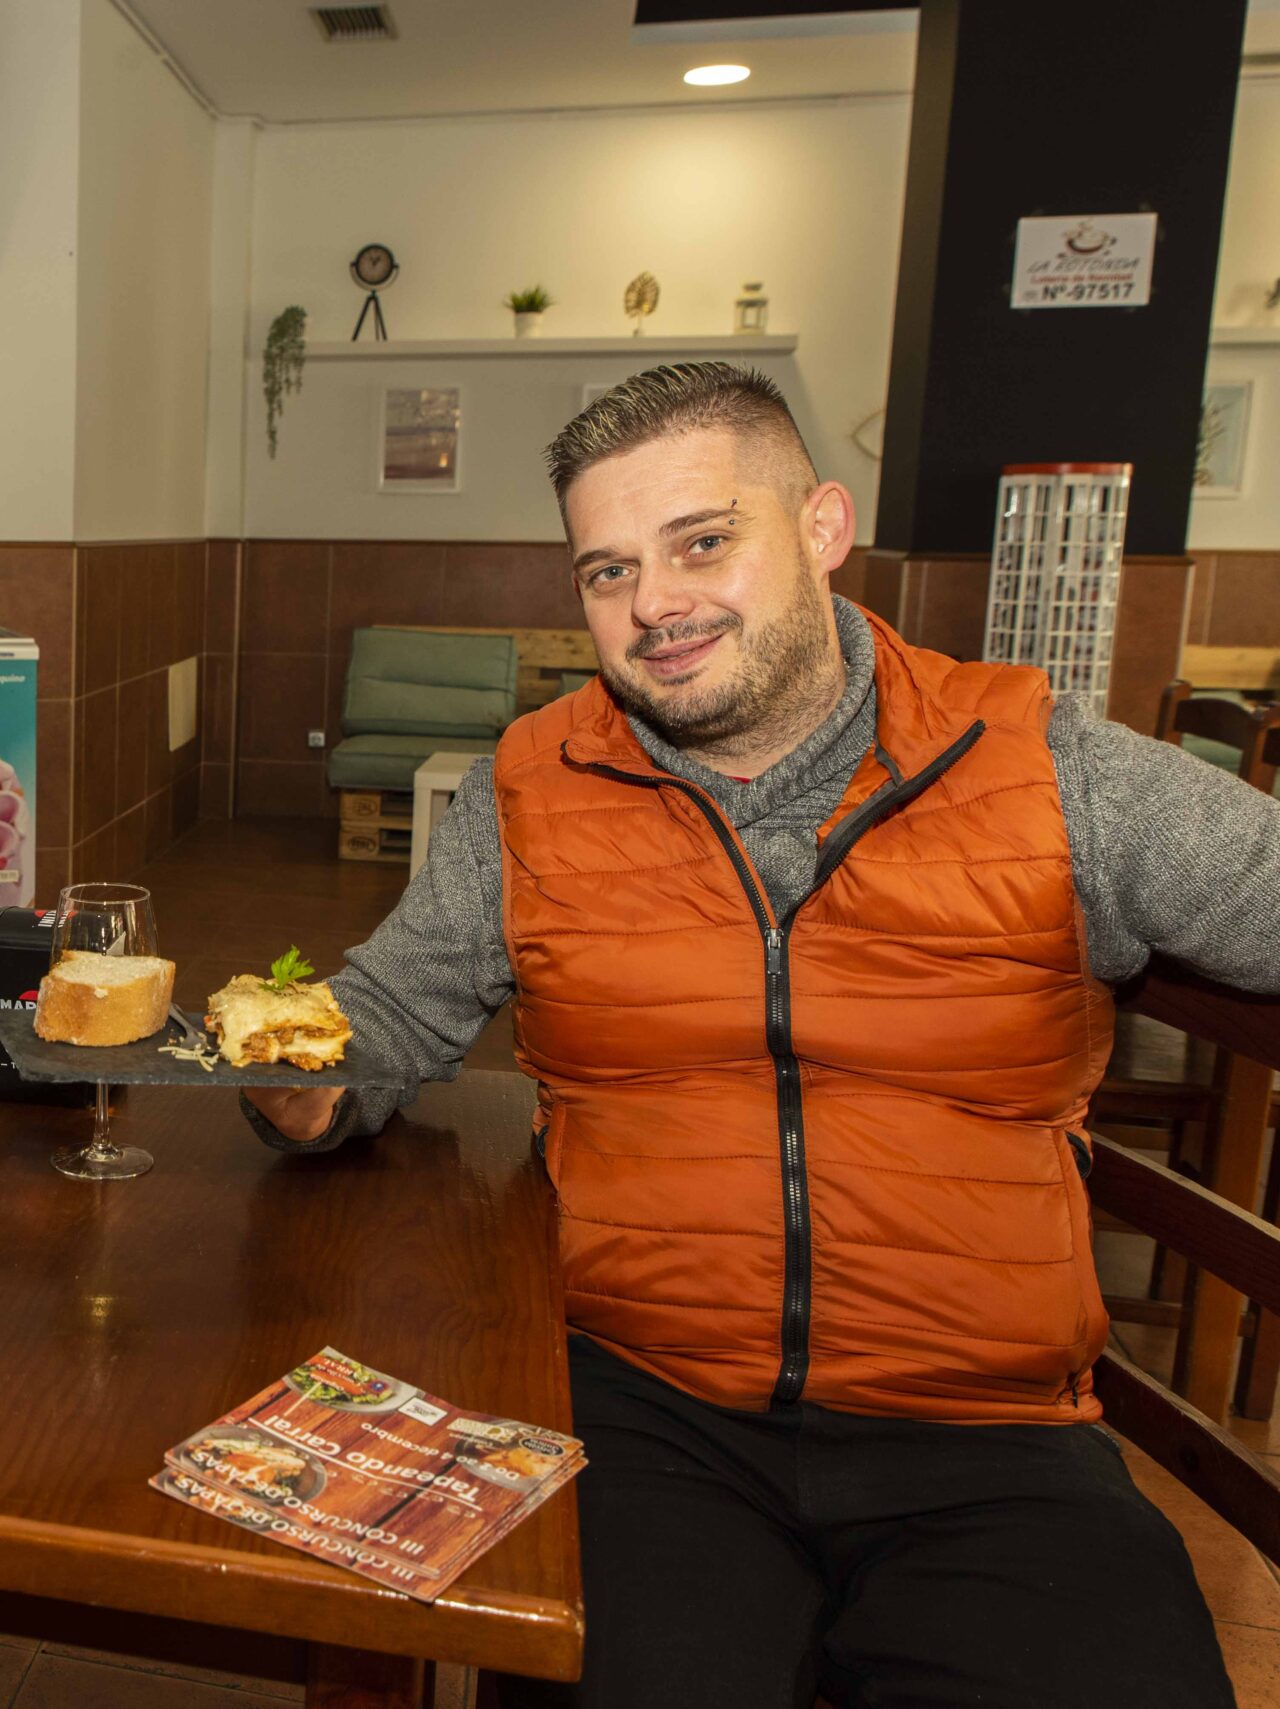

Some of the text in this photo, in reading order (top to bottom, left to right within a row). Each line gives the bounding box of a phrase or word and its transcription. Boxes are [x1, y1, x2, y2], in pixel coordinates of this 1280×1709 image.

[361, 1422, 440, 1457] decembro
[440, 1451, 454, 1460] 4
[263, 1415, 480, 1503] Tapeando Carral
[456, 1455, 478, 1466] ao
[495, 1466, 520, 1480] Do
[190, 1449, 425, 1556] III CONCURSO DE TAPAS
[174, 1476, 416, 1581] III CONCURSO DE TAPAS
